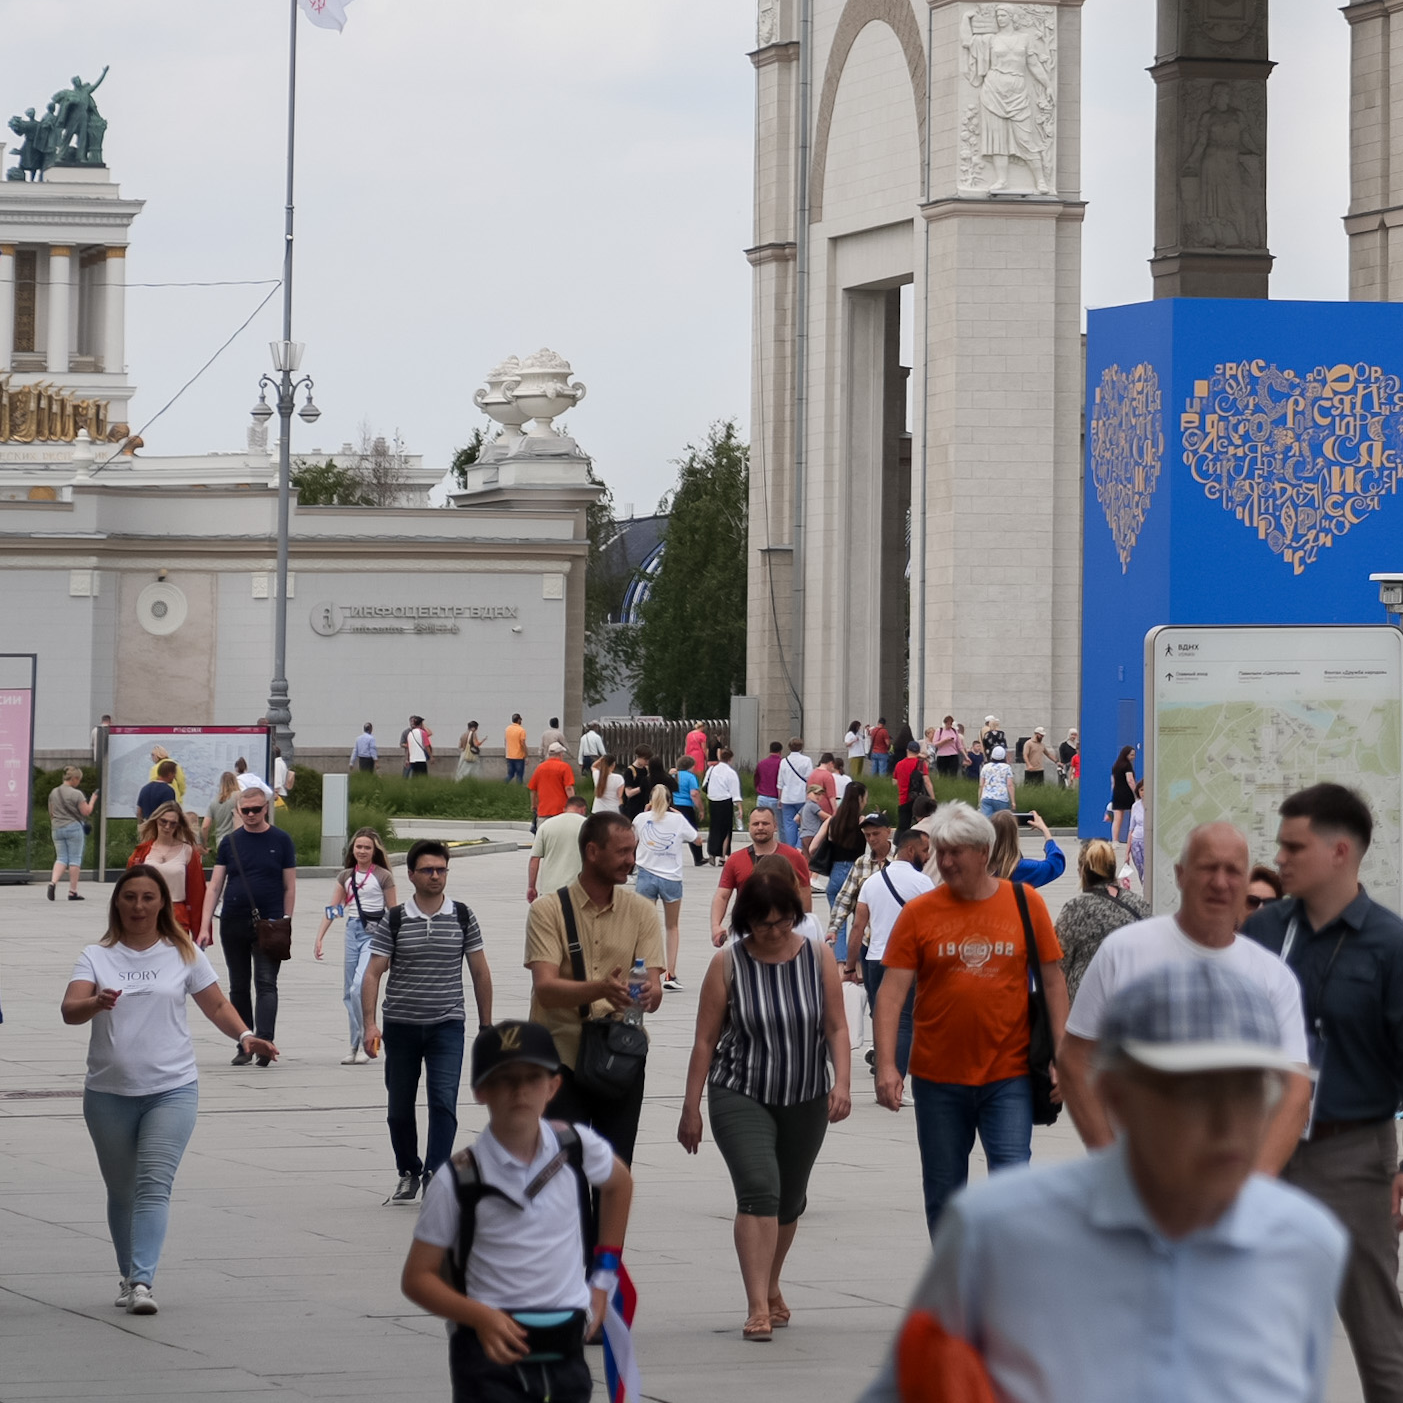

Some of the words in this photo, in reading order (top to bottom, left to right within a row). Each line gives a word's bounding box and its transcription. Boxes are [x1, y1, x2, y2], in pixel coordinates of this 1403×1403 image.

[350, 605, 466, 619] ИНФОЦЕНТР
[471, 605, 518, 620] ВДНХ
[1178, 643, 1200, 651] ВДНХ
[118, 968, 161, 981] STORY
